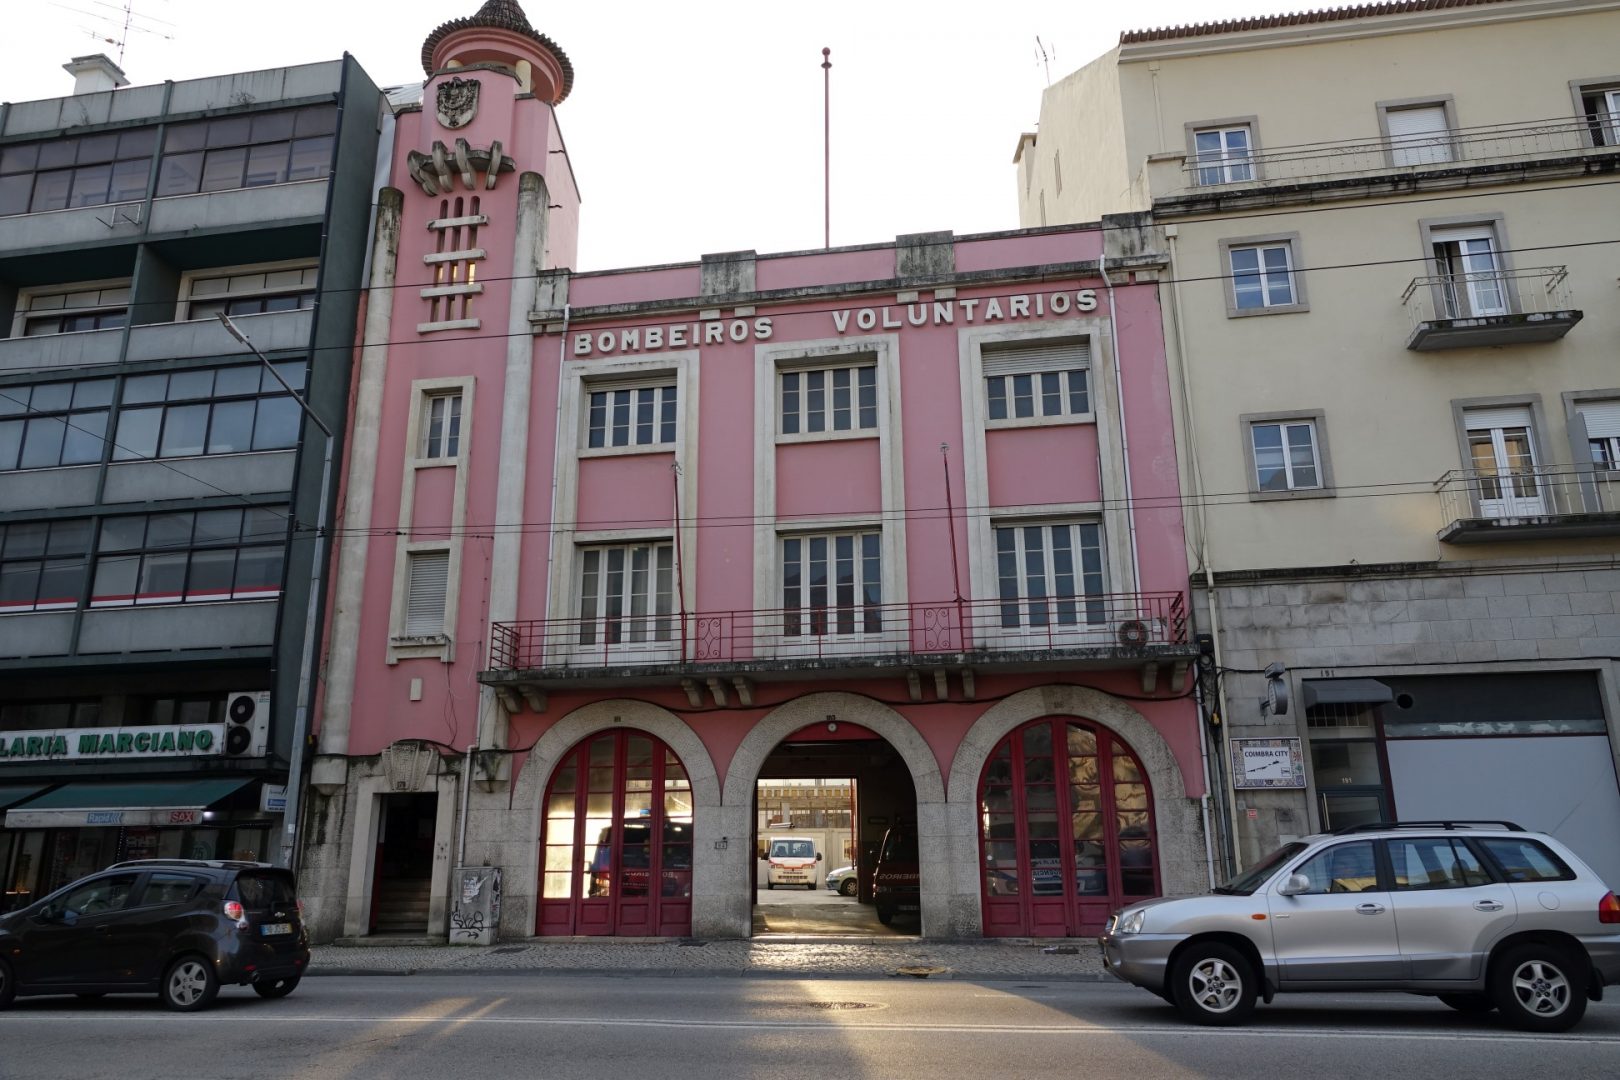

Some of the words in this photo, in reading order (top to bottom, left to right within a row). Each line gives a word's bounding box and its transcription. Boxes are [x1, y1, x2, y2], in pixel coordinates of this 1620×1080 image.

[574, 316, 774, 356] BOMBEIROS
[832, 290, 1098, 333] VOLUNTARIOS
[0, 735, 67, 757] LARIA
[78, 729, 214, 754] MARCIANO
[89, 812, 110, 823] Rapid
[171, 811, 193, 822] SAX
